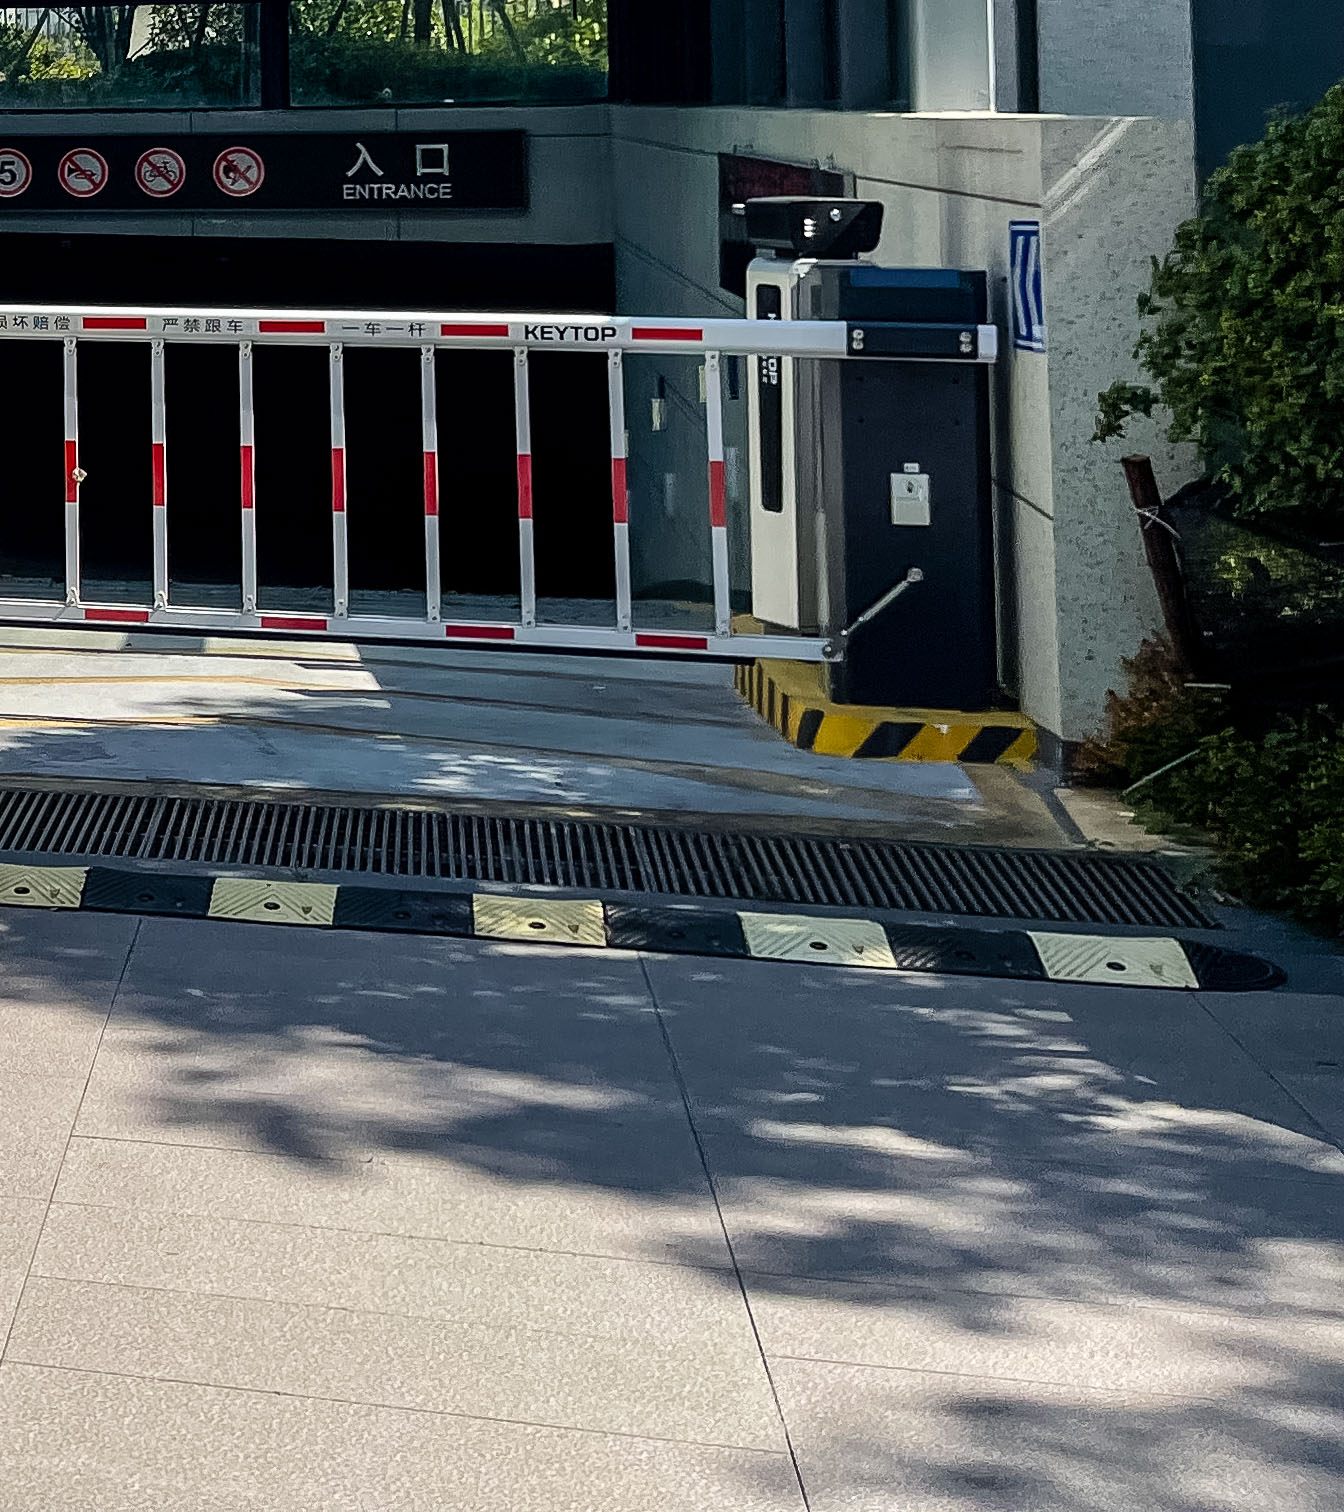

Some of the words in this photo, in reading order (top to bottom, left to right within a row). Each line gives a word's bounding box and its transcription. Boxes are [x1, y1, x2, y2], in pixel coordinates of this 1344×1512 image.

[346, 142, 449, 176] 入口
[0, 160, 17, 186] 5
[343, 183, 452, 199] ENTRANCE
[162, 318, 243, 333] 严禁跟车
[342, 322, 426, 337] 一车一杆
[524, 325, 617, 341] KEYTOP
